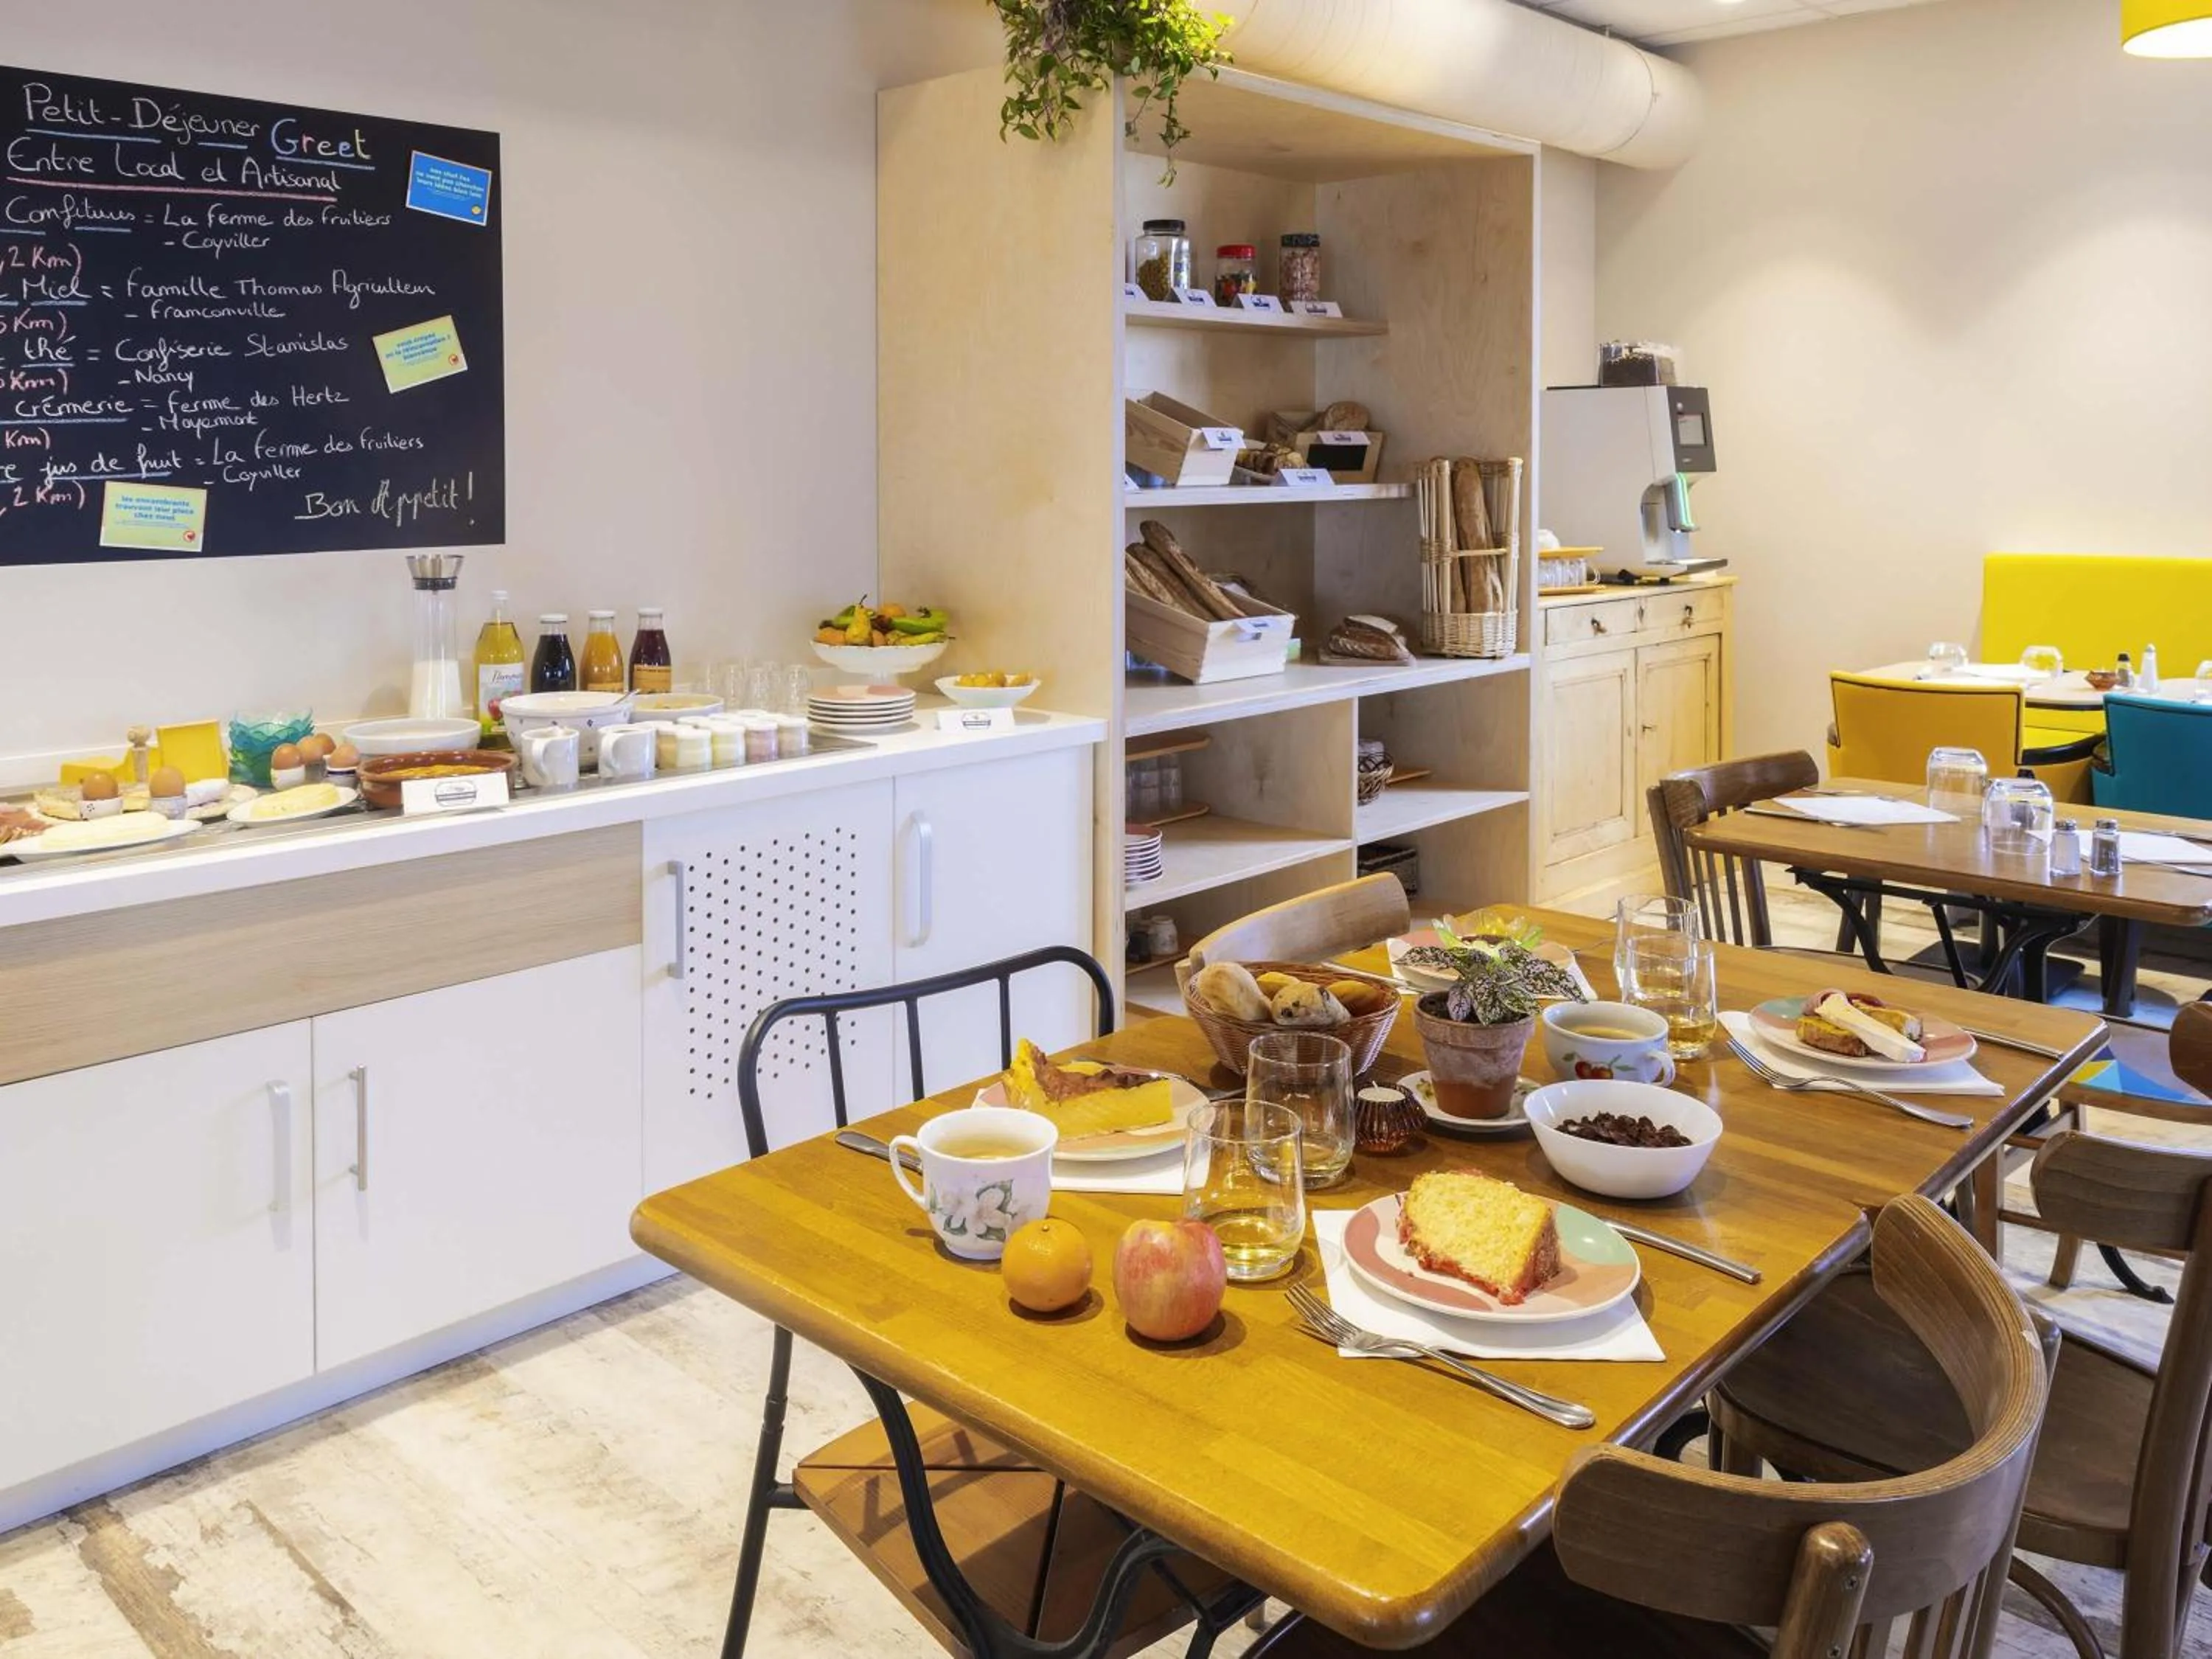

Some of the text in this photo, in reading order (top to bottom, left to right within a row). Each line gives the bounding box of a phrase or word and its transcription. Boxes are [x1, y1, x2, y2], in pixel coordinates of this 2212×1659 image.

[271, 119, 371, 159] Greet
[7, 136, 95, 173] Entre
[115, 142, 185, 180] Local
[241, 156, 341, 192] Artisanal
[163, 203, 198, 226] La
[283, 208, 313, 226] des
[22, 274, 91, 300] Miel
[234, 276, 321, 295] Thomas
[24, 336, 77, 361] thé
[115, 338, 232, 372] Confiserie
[245, 332, 349, 357] Stanislas
[136, 366, 193, 393] Nancy
[251, 391, 279, 406] des
[291, 385, 350, 407] Hertz
[39, 455, 77, 490] jus
[91, 452, 125, 473] de
[212, 437, 246, 465] La
[324, 434, 354, 453] des
[294, 493, 361, 518] Bon
